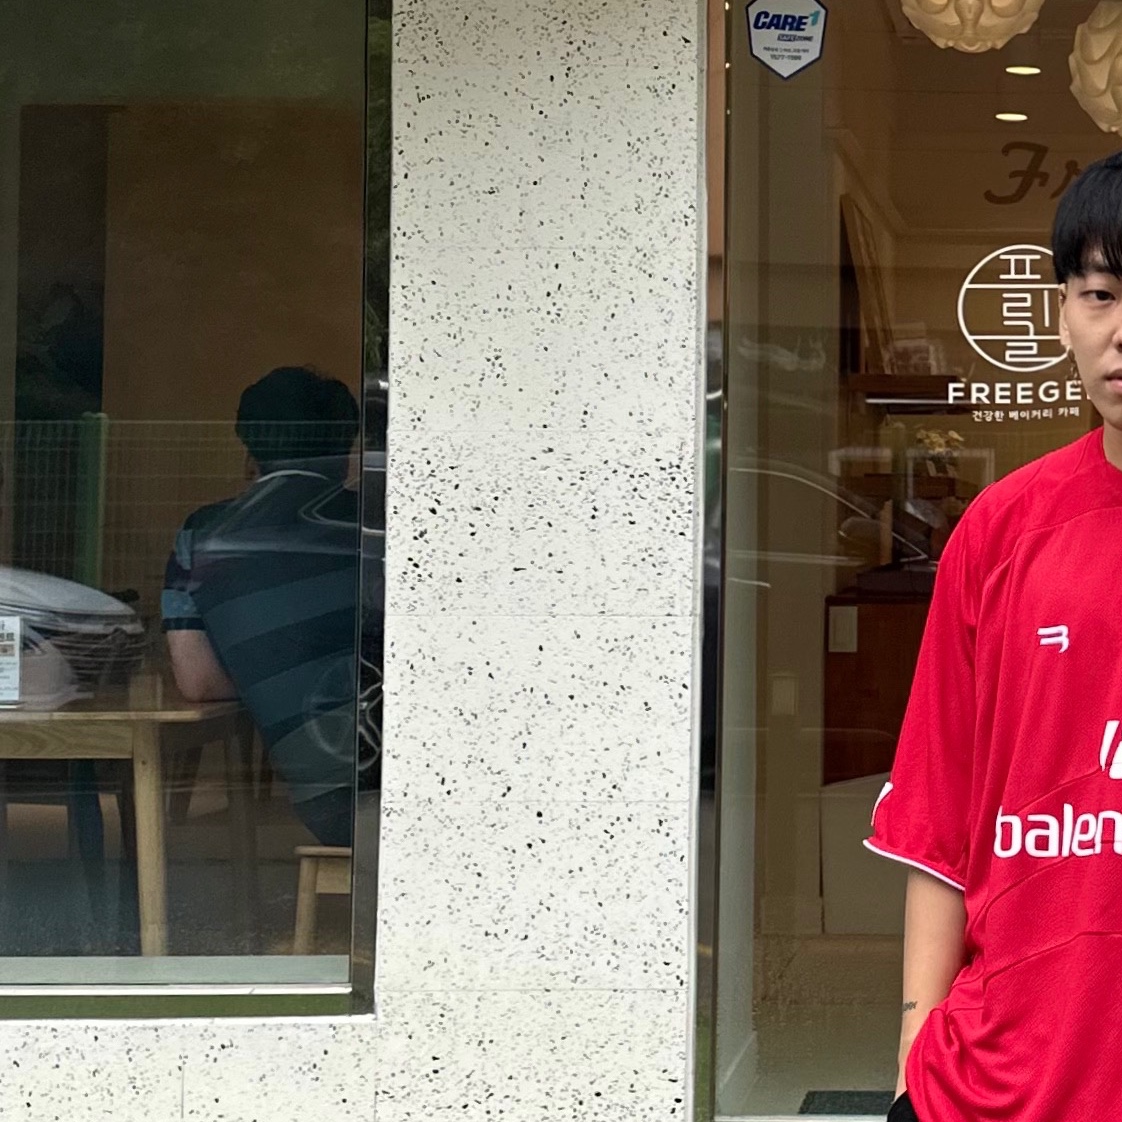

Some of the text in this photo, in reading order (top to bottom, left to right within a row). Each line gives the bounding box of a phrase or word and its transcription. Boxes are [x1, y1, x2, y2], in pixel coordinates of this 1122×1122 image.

[947, 380, 1092, 405] FREEGE
[972, 406, 1080, 422] 건강한 베이커리 카페
